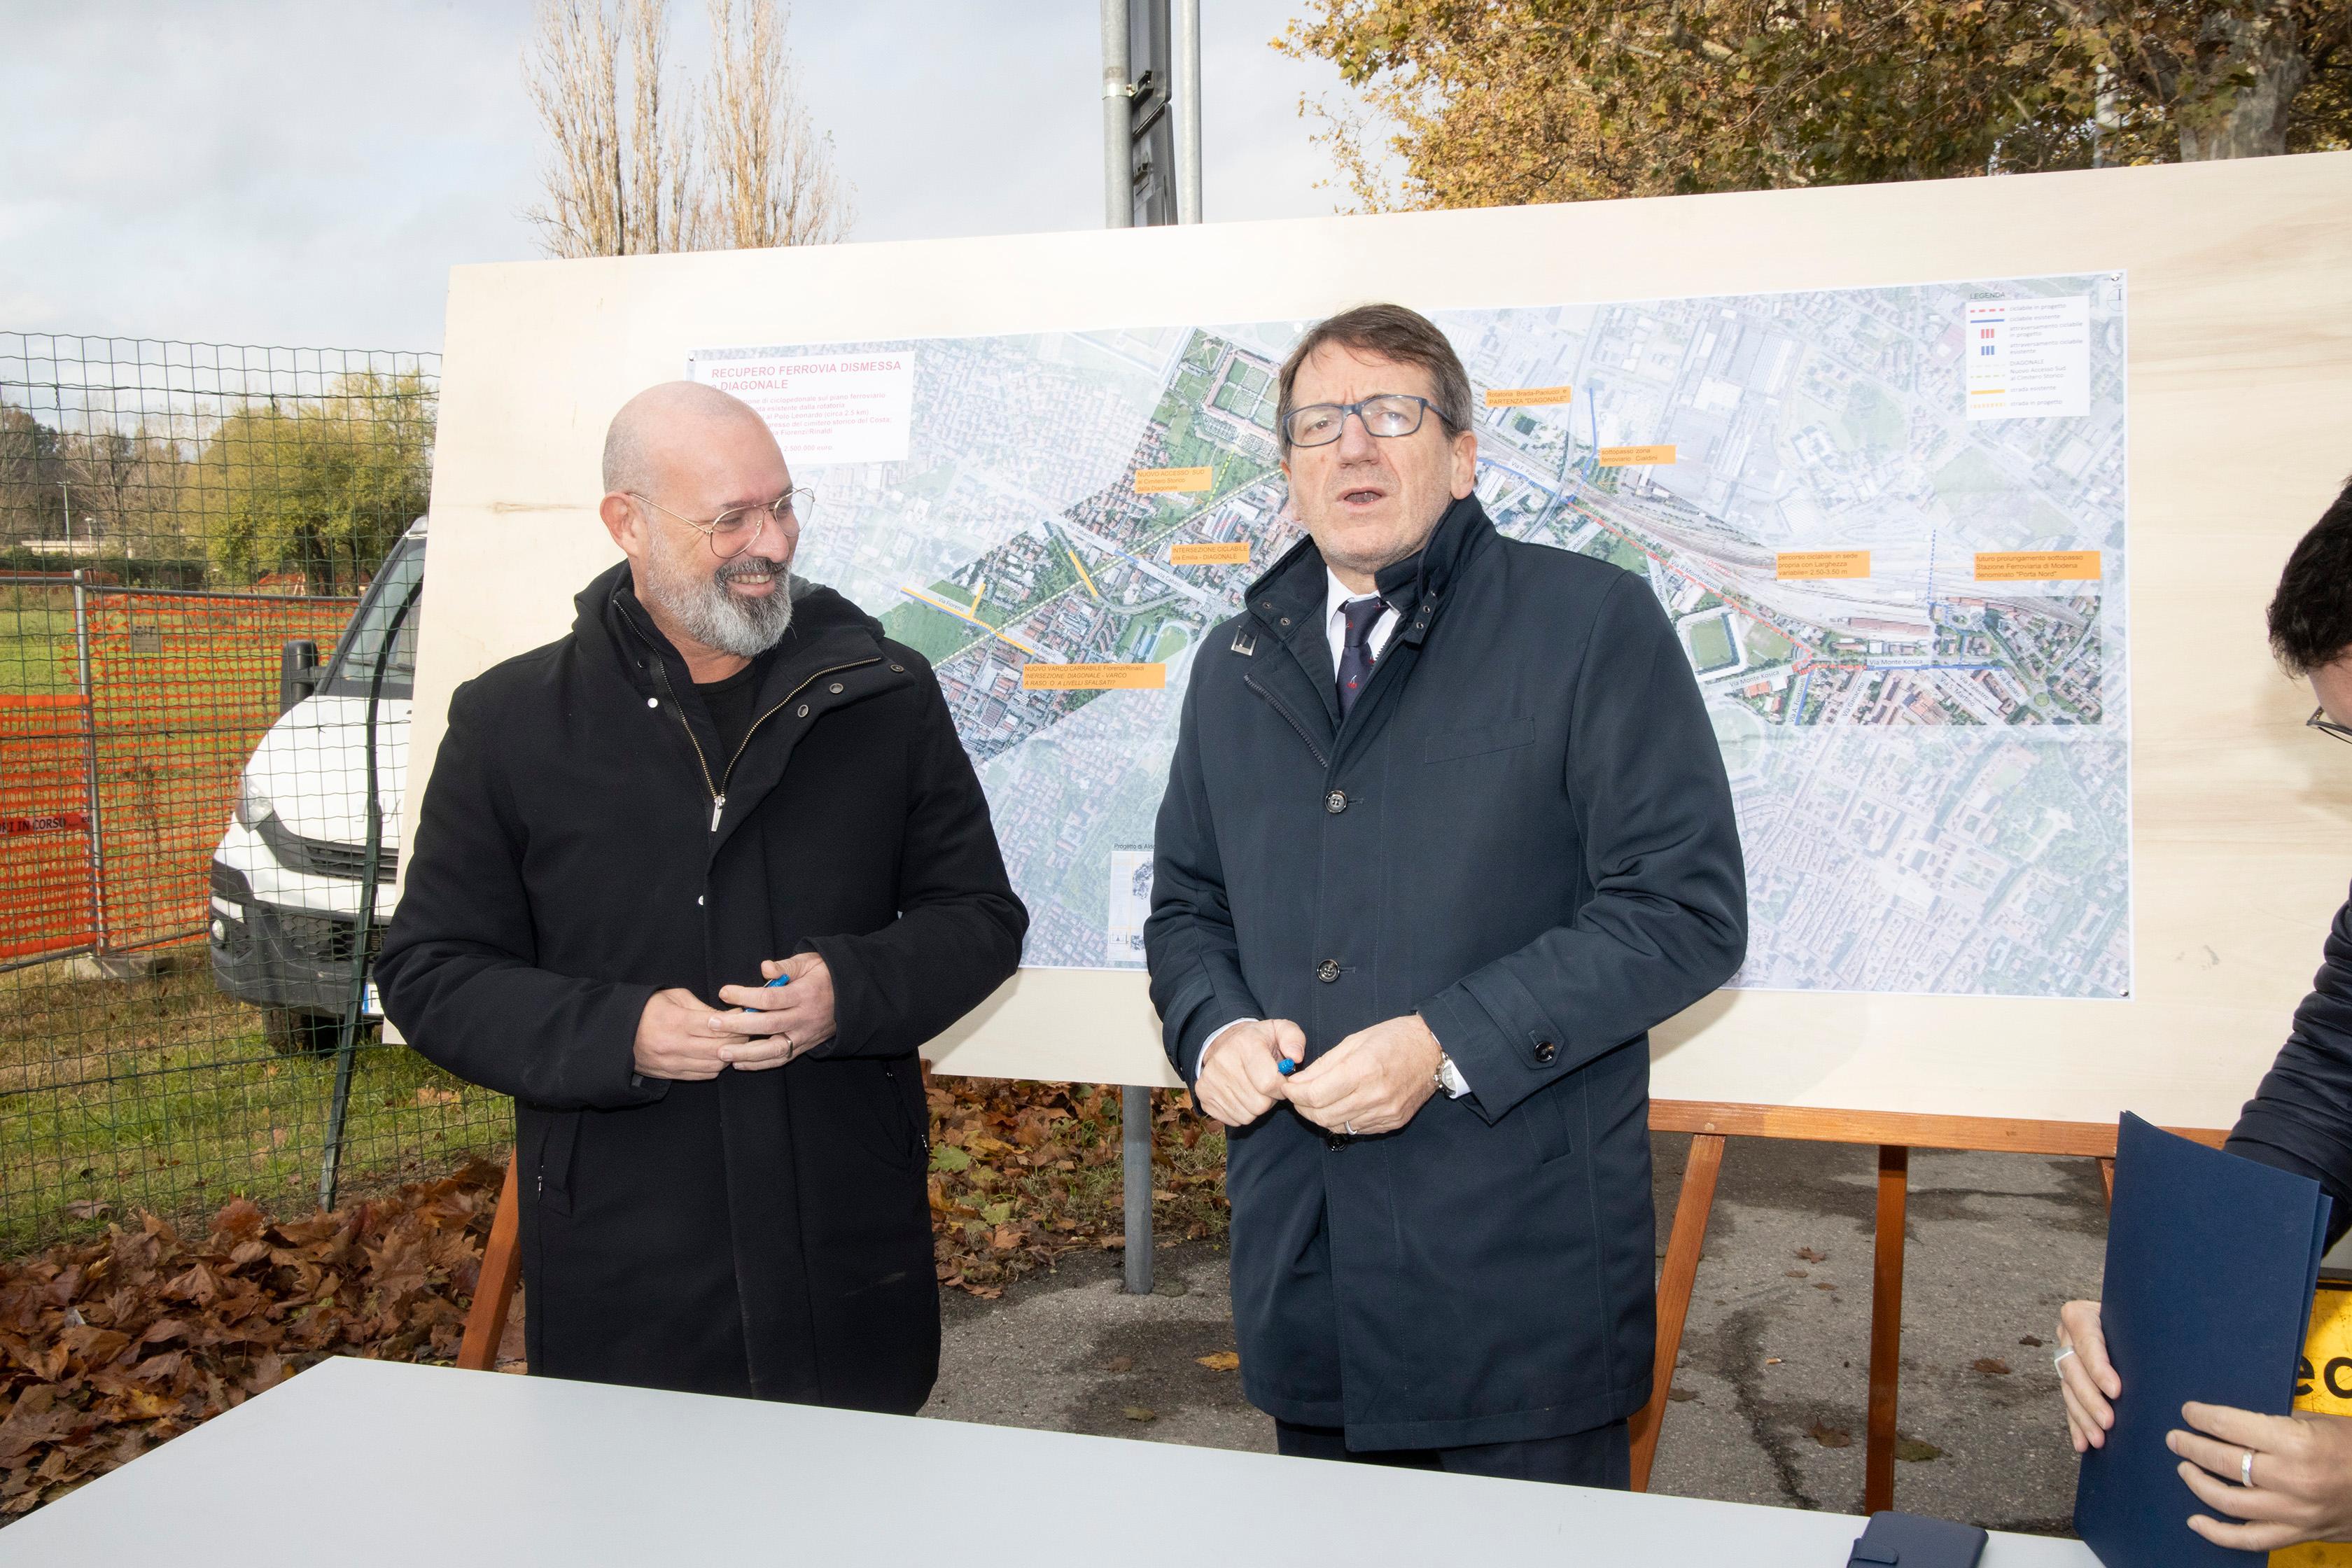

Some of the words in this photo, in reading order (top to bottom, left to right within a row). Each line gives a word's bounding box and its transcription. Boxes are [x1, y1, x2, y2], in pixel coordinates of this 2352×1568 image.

[711, 367, 776, 379] RECUPERO
[779, 363, 837, 376] FERROVIA
[840, 360, 902, 372] DISMESSA
[720, 380, 789, 391] DIAGONALE
[770, 396, 817, 405] ciclopedonale
[830, 394, 849, 402] piano
[1996, 554, 2046, 563] prolungamento
[1740, 675, 1760, 685] Monte
[1760, 670, 1780, 679] Kosica
[1998, 671, 2007, 682] Via
[2005, 680, 2022, 698] Bonasi
[1940, 676, 1949, 687] Via
[1954, 687, 1975, 707] Martino
[1959, 675, 1968, 685] Via
[1968, 682, 1990, 701] Palestro
[18, 820, 30, 832] IN
[34, 816, 66, 830] CORSO
[1114, 843, 1137, 851] Progetto
